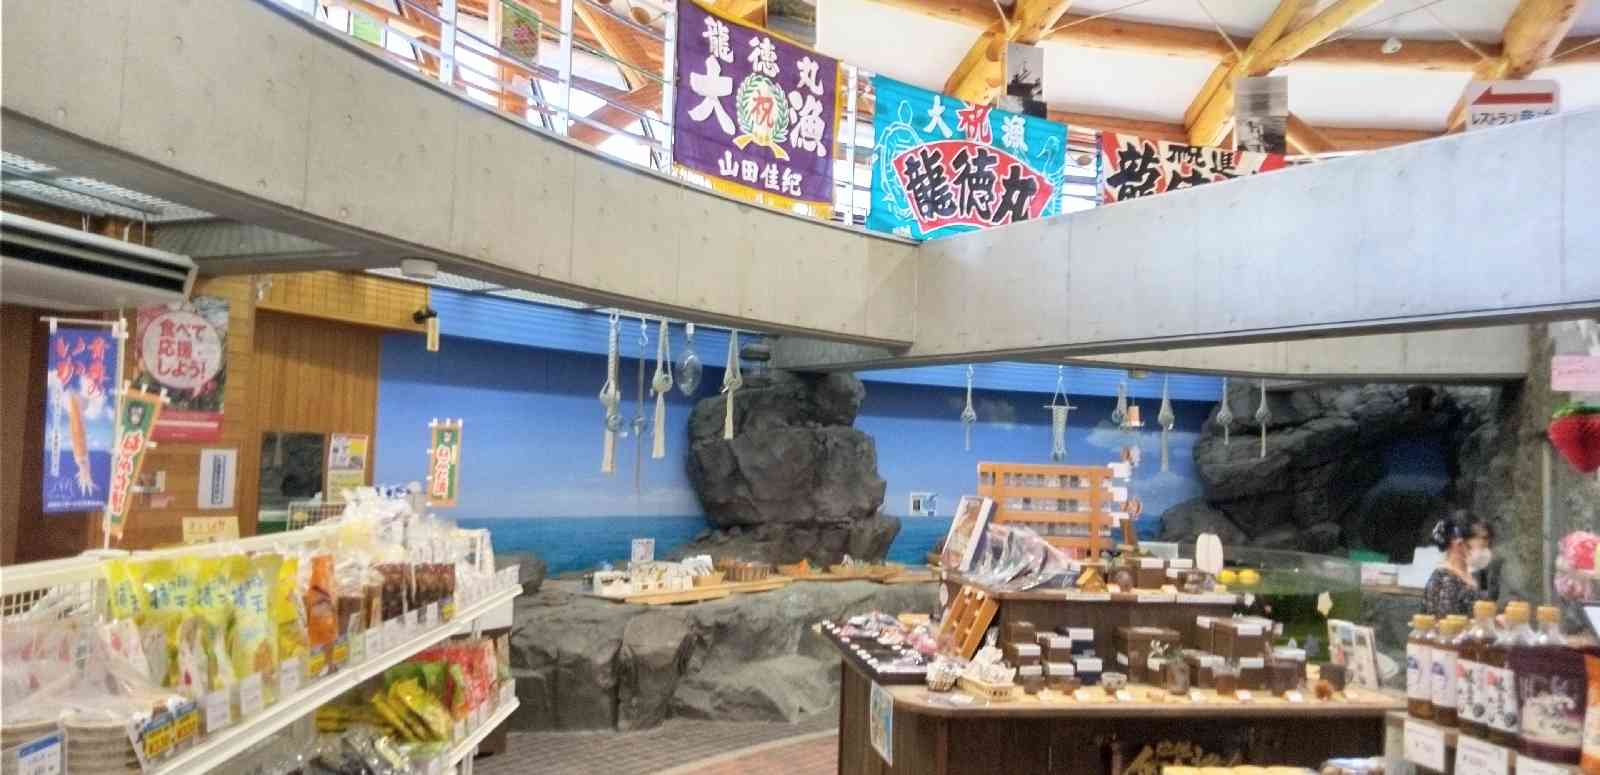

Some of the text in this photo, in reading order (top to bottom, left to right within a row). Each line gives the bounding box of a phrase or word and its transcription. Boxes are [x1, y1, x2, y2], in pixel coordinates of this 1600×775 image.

[688, 56, 735, 136] 大
[904, 147, 1037, 224] 龍徳丸
[158, 338, 195, 360] 応援
[159, 318, 207, 343] 食べて
